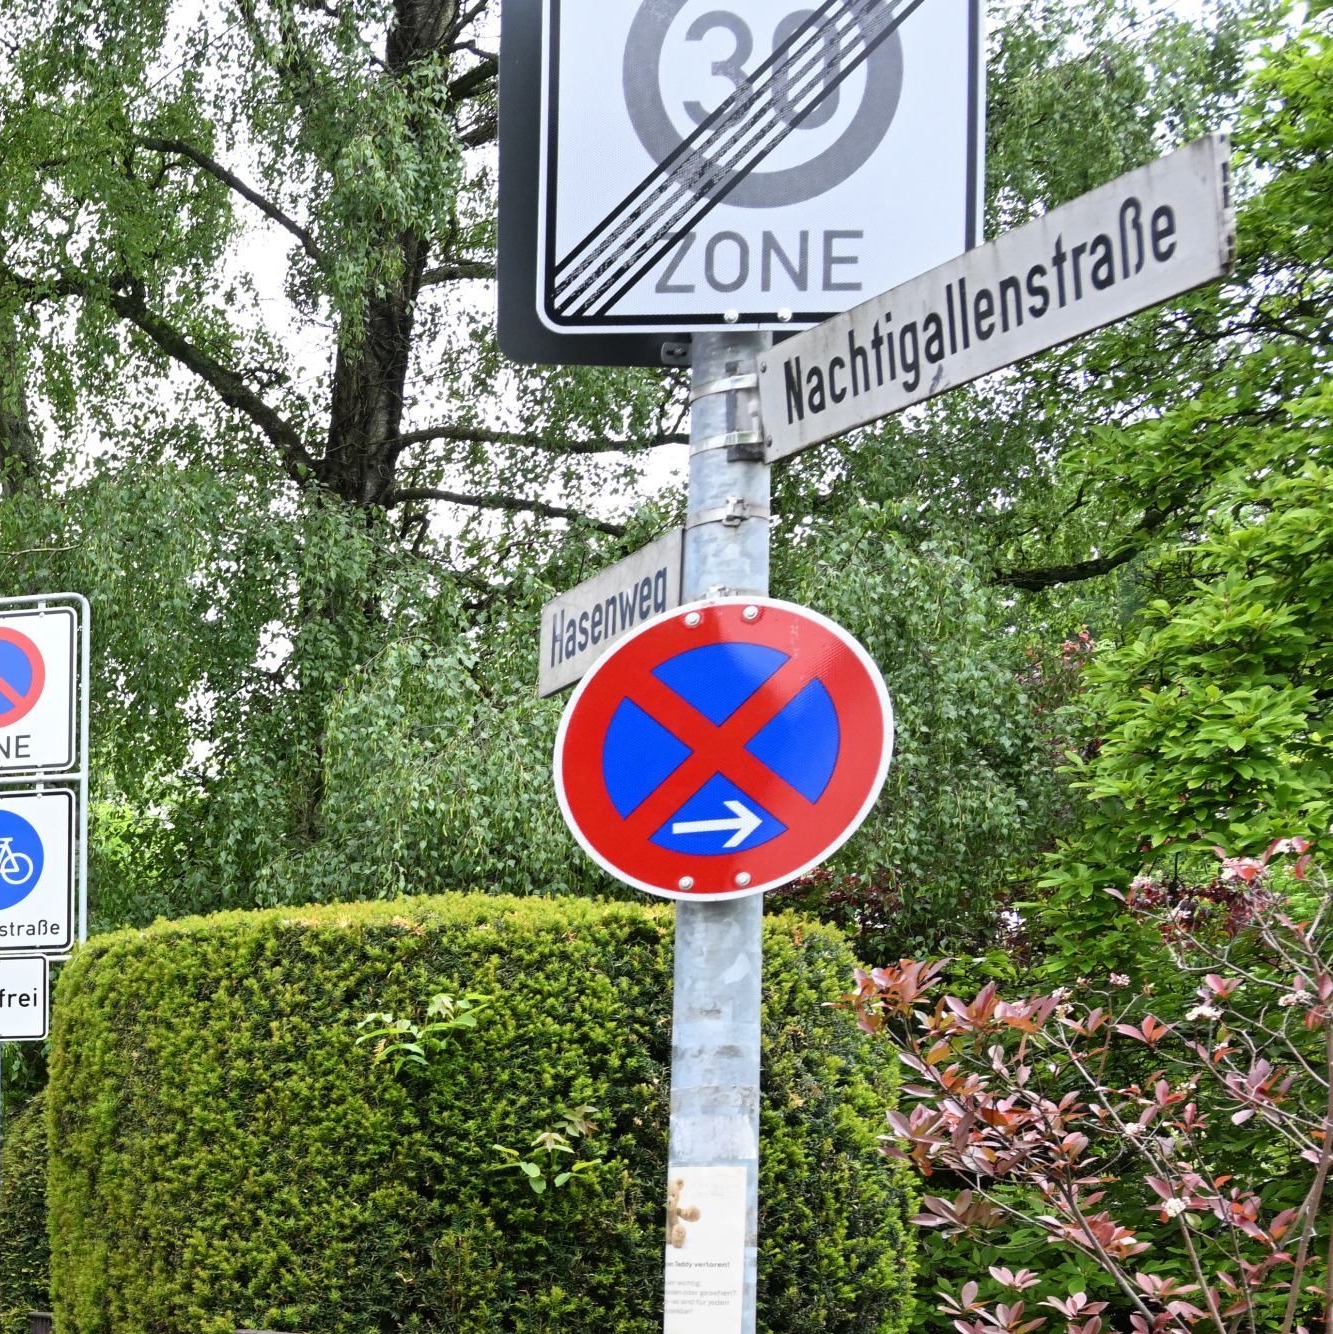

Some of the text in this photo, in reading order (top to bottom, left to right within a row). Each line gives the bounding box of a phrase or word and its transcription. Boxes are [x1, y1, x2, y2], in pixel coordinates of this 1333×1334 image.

[682, 8, 841, 131] 30
[654, 229, 864, 293] ZONE
[783, 197, 1176, 424] Nachtigallenstraße
